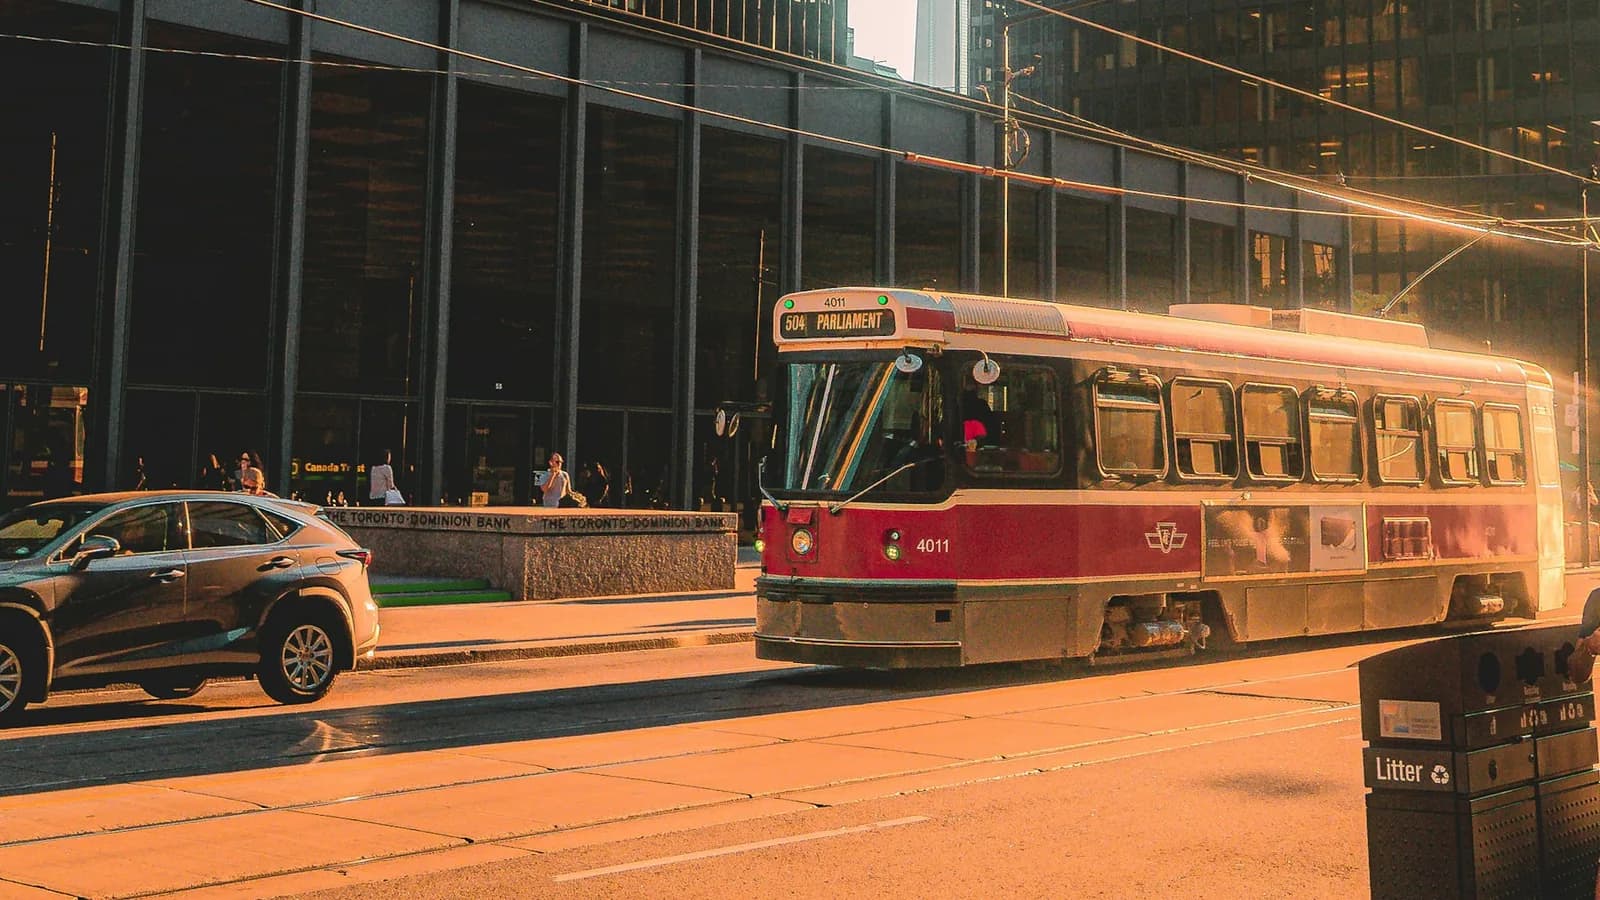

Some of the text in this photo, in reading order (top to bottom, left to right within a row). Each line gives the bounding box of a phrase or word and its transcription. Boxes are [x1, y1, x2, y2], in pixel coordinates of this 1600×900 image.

[824, 297, 846, 308] 4011
[785, 312, 883, 331] 504 PARLIAMENT
[304, 462, 340, 473] Canada
[340, 463, 366, 473] Trst
[477, 517, 511, 529] BANK
[541, 518, 565, 529] THE
[916, 539, 949, 552] 4011
[1376, 756, 1423, 782] Litter
